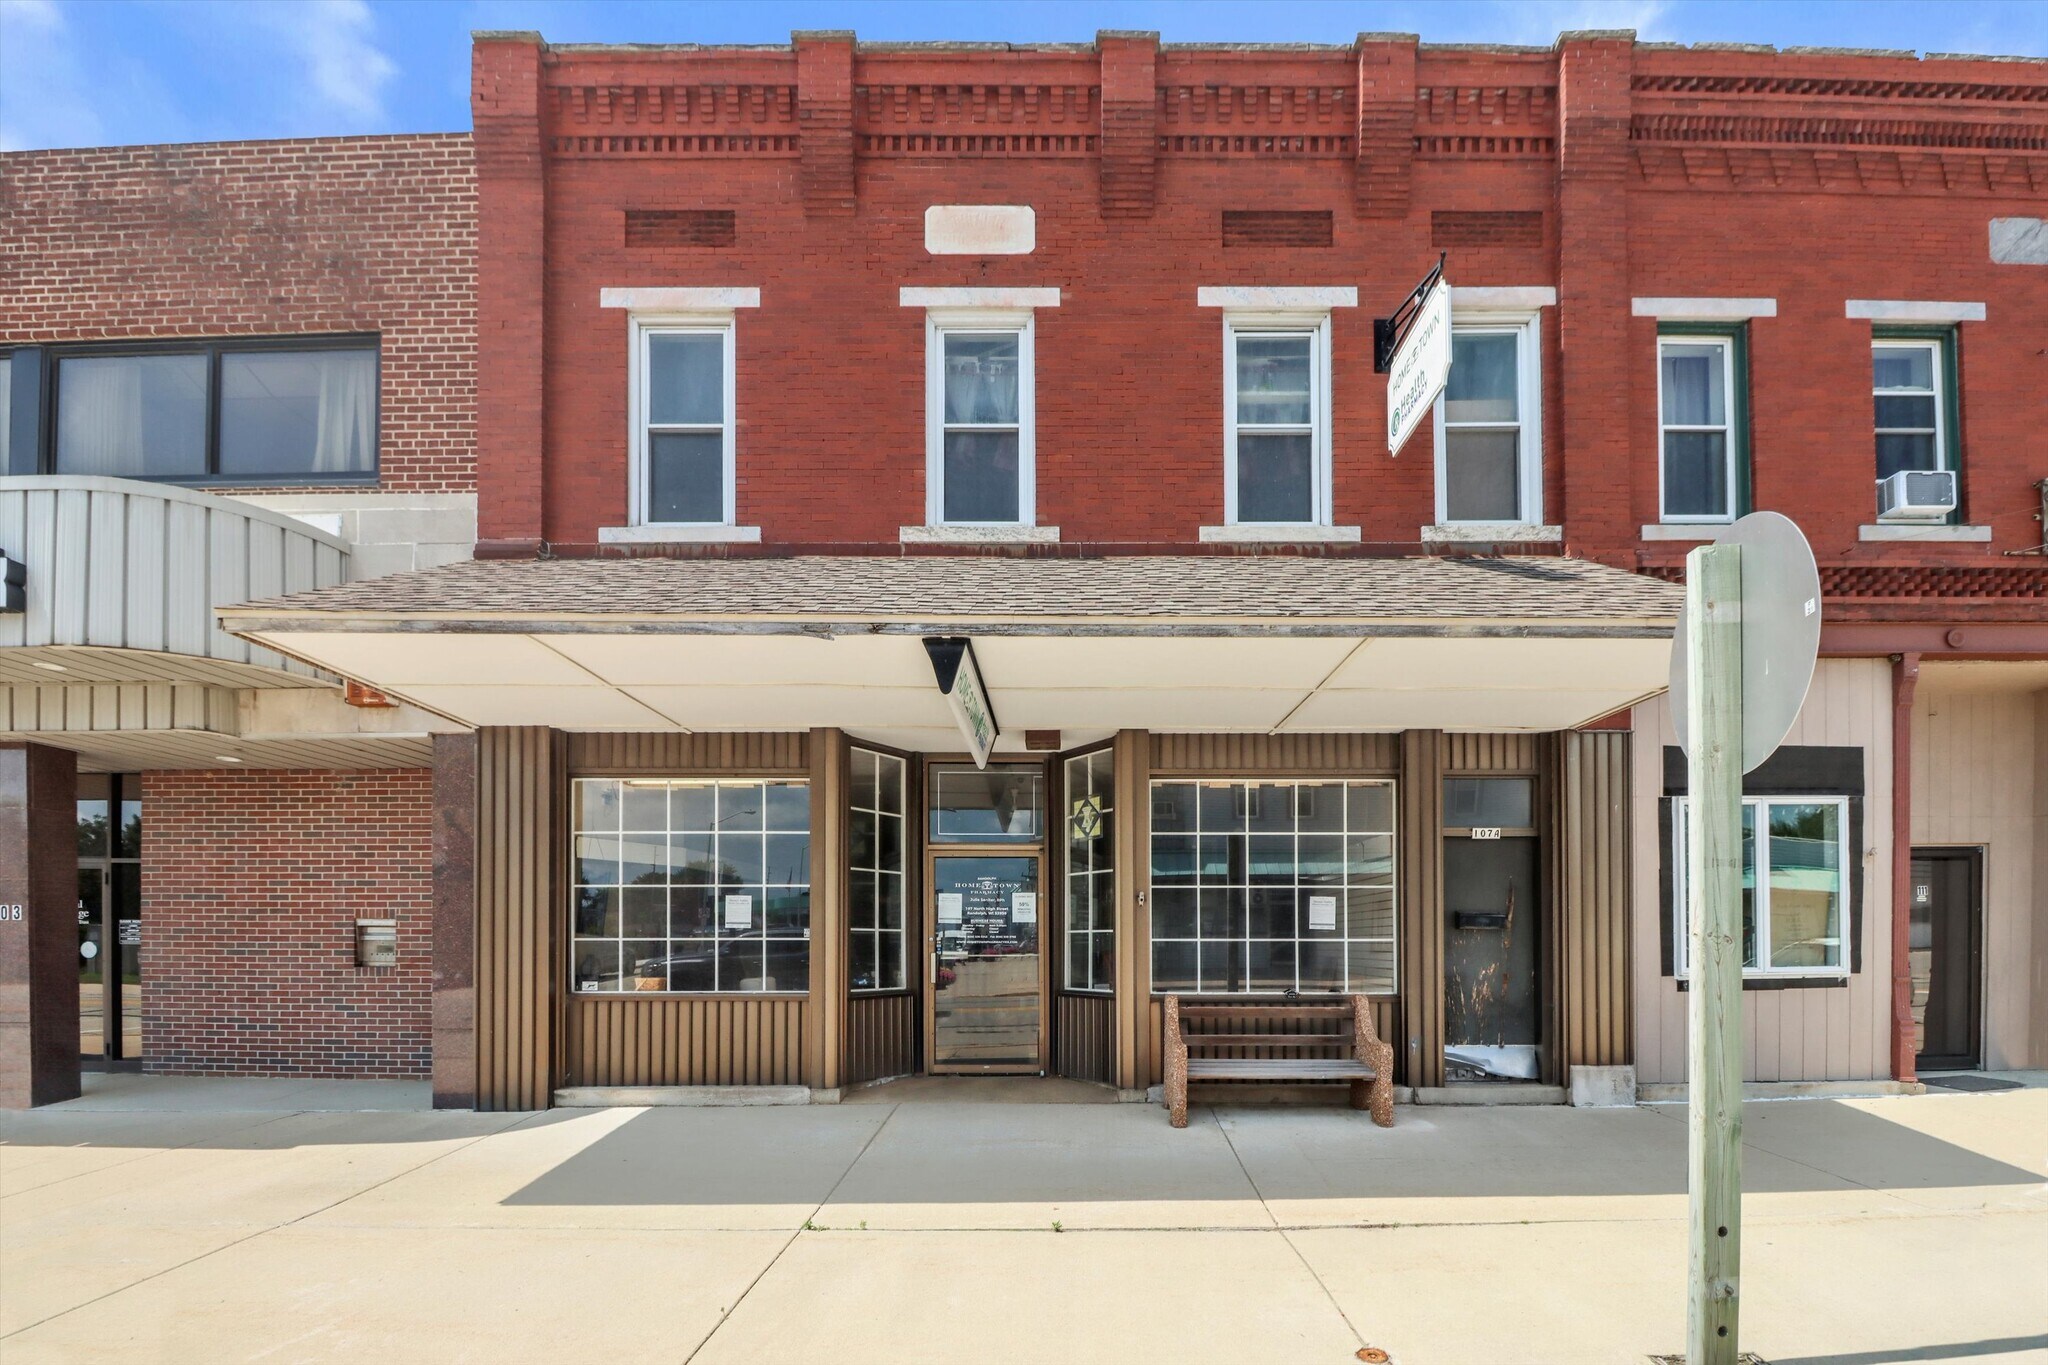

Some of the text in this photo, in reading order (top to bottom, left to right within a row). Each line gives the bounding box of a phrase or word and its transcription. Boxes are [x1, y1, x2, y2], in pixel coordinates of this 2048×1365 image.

[1392, 310, 1440, 396] HOME TOWN
[1400, 369, 1425, 412] Health
[1401, 378, 1428, 424] PHARMACY
